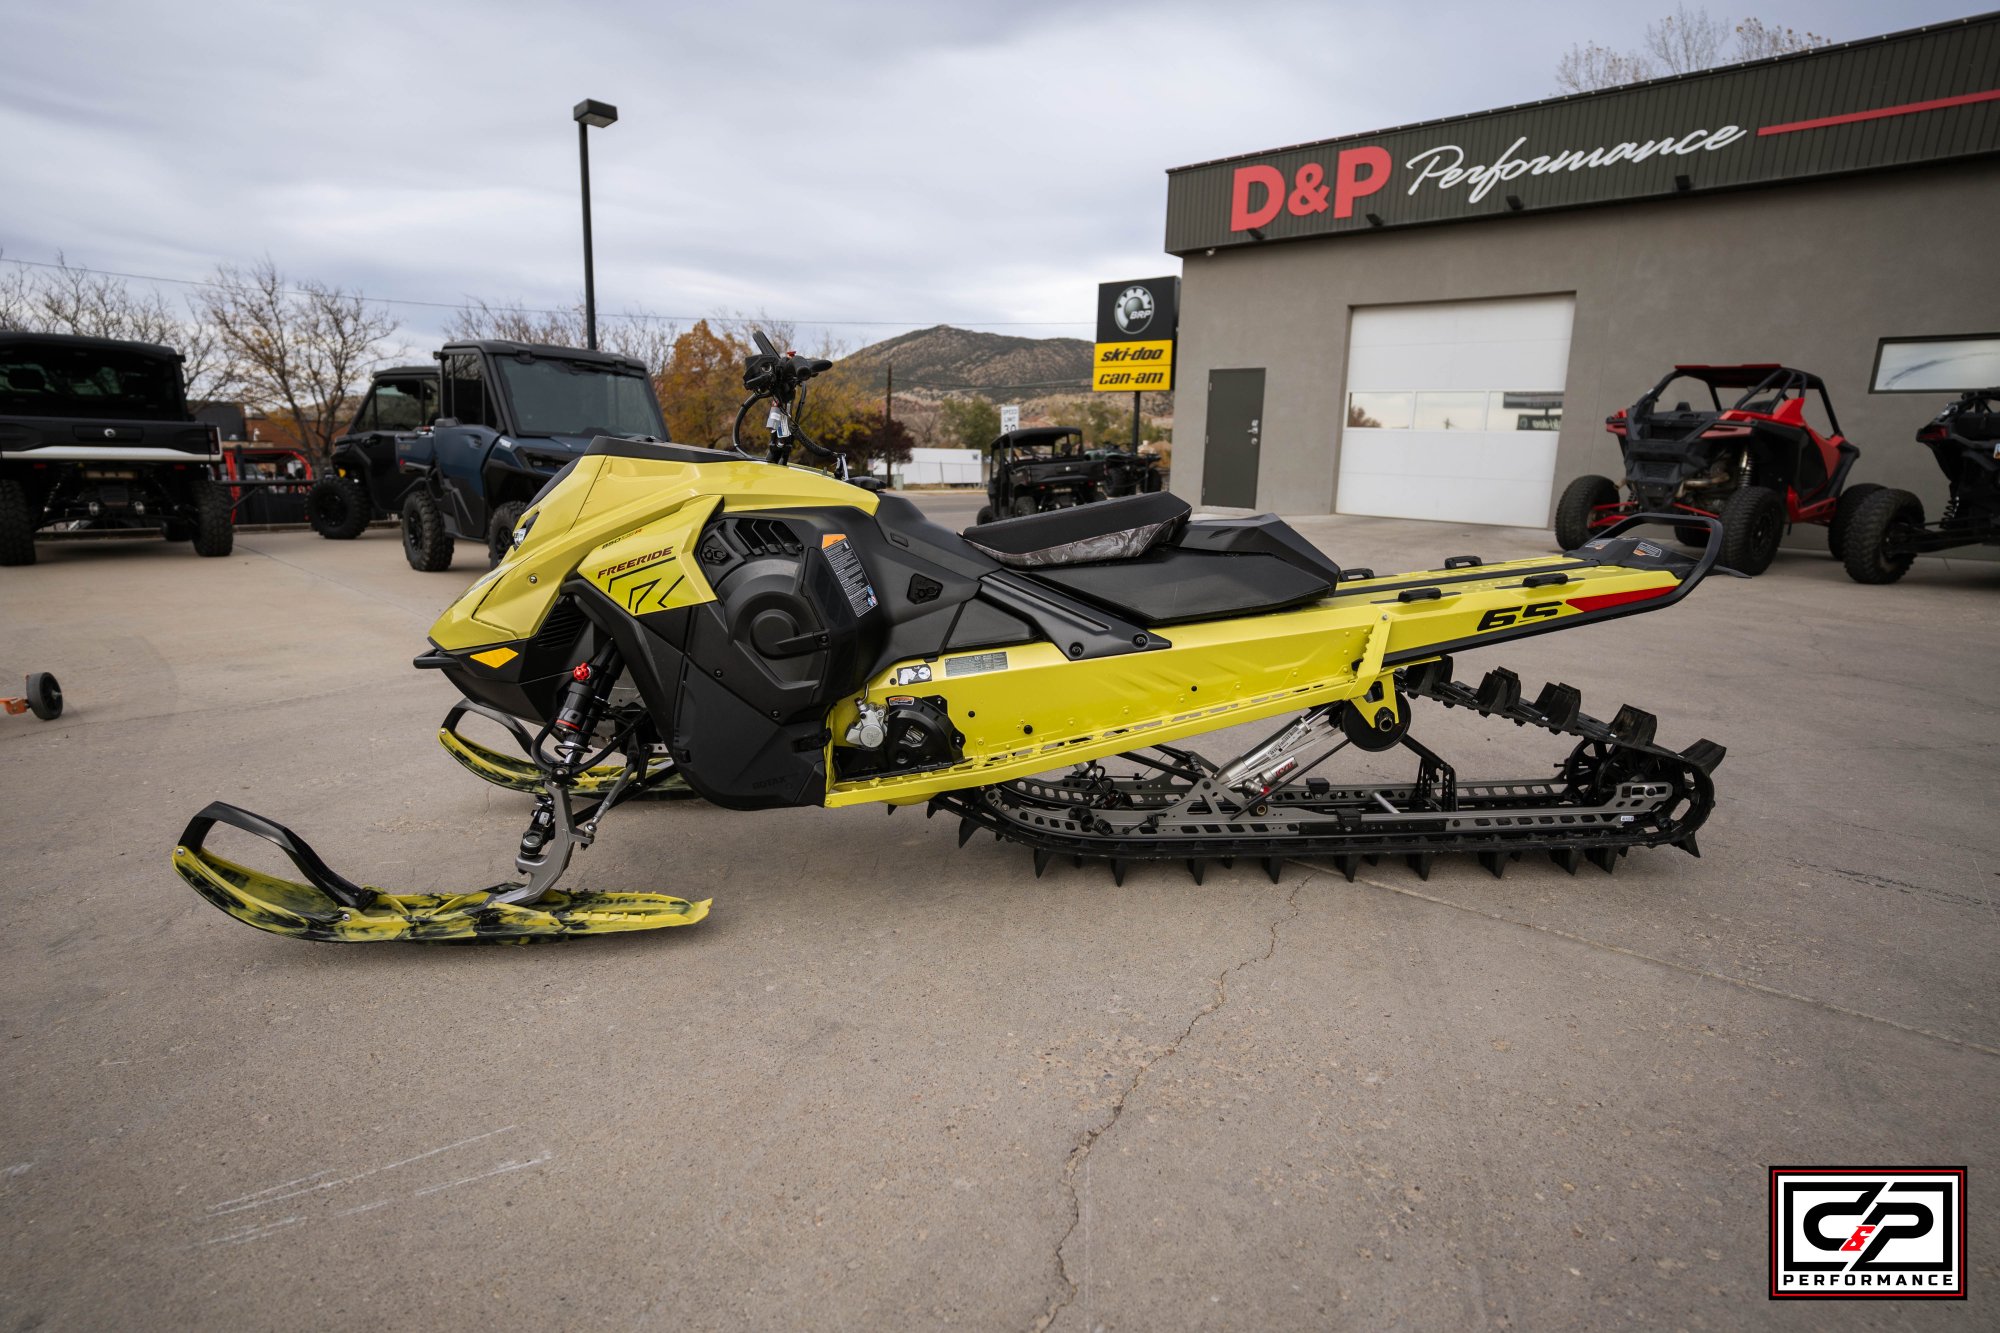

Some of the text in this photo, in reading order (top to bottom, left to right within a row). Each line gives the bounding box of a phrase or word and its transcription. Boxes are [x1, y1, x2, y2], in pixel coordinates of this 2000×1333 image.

[1230, 124, 1747, 232] D&P Performance
[1130, 309, 1152, 320] BRP
[1100, 346, 1164, 362] ski-doo
[1098, 371, 1164, 385] can-am
[597, 546, 674, 579] FREERIDE
[1477, 600, 1563, 632] 65
